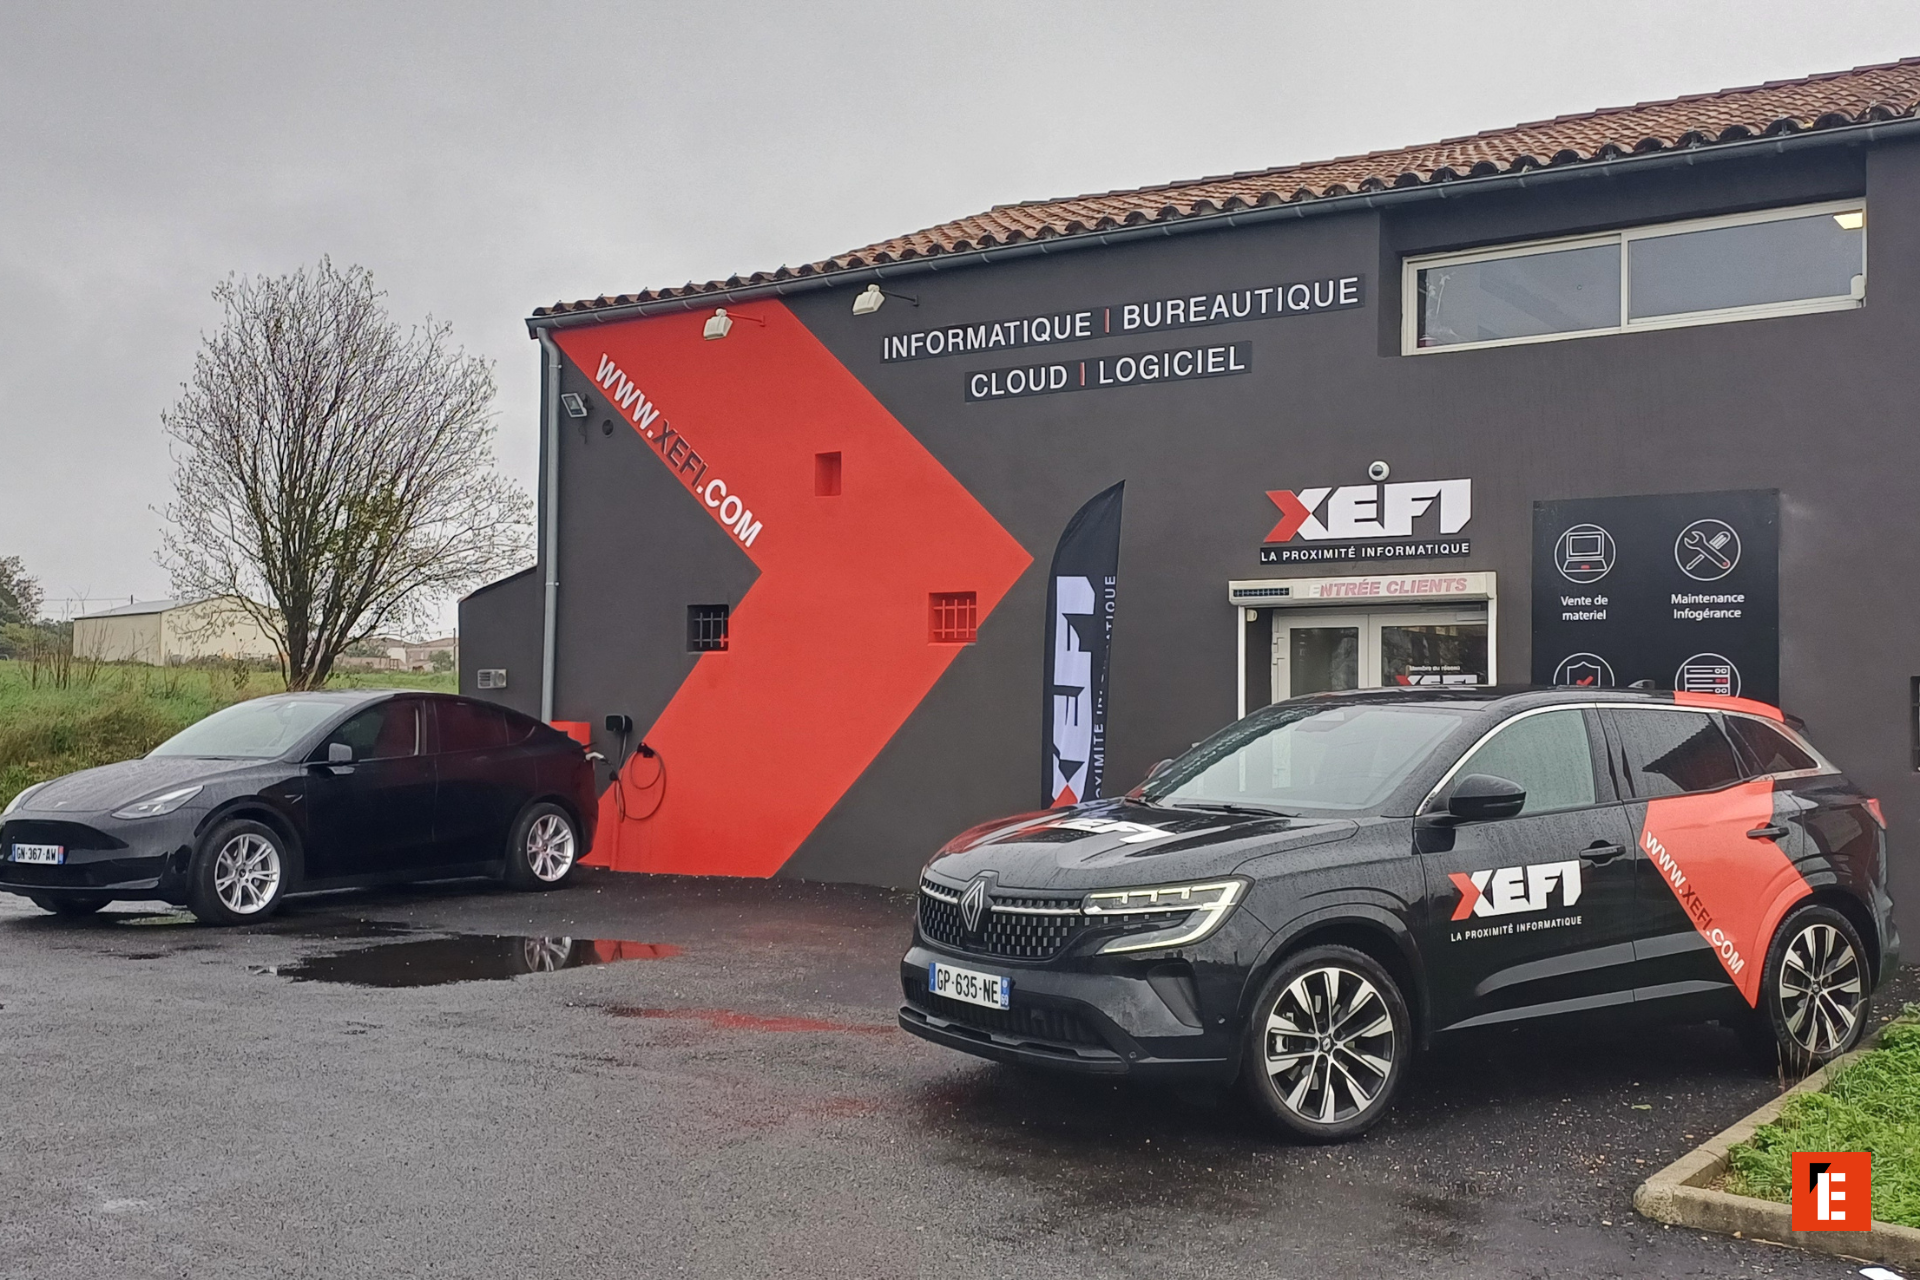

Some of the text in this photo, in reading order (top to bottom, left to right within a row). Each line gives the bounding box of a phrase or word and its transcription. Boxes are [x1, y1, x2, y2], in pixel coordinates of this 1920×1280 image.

[883, 311, 1092, 360] INFORMATIQUE
[1123, 277, 1360, 330] BUREAUTIQUE
[971, 364, 1068, 398] CLOUD
[1099, 345, 1245, 385] LOGICIEL
[594, 353, 763, 548] WWW.XEFI.COM
[1263, 478, 1472, 543] XEFI
[1261, 542, 1470, 562] LA PROXIMITÉ INFORMATIQUE
[1386, 577, 1467, 595] CLIENTS
[1560, 594, 1608, 606] Vente de
[1670, 593, 1745, 604] Maintenance
[1562, 608, 1607, 620] materiel
[1673, 607, 1742, 621] Infogérance
[1447, 859, 1582, 921] XEFI
[1644, 831, 1745, 975] WWW.XEFI.COM
[1450, 915, 1582, 942] LA PROXIMITÉ INFORMATIQUE
[937, 968, 999, 1004] GP-635-NE
